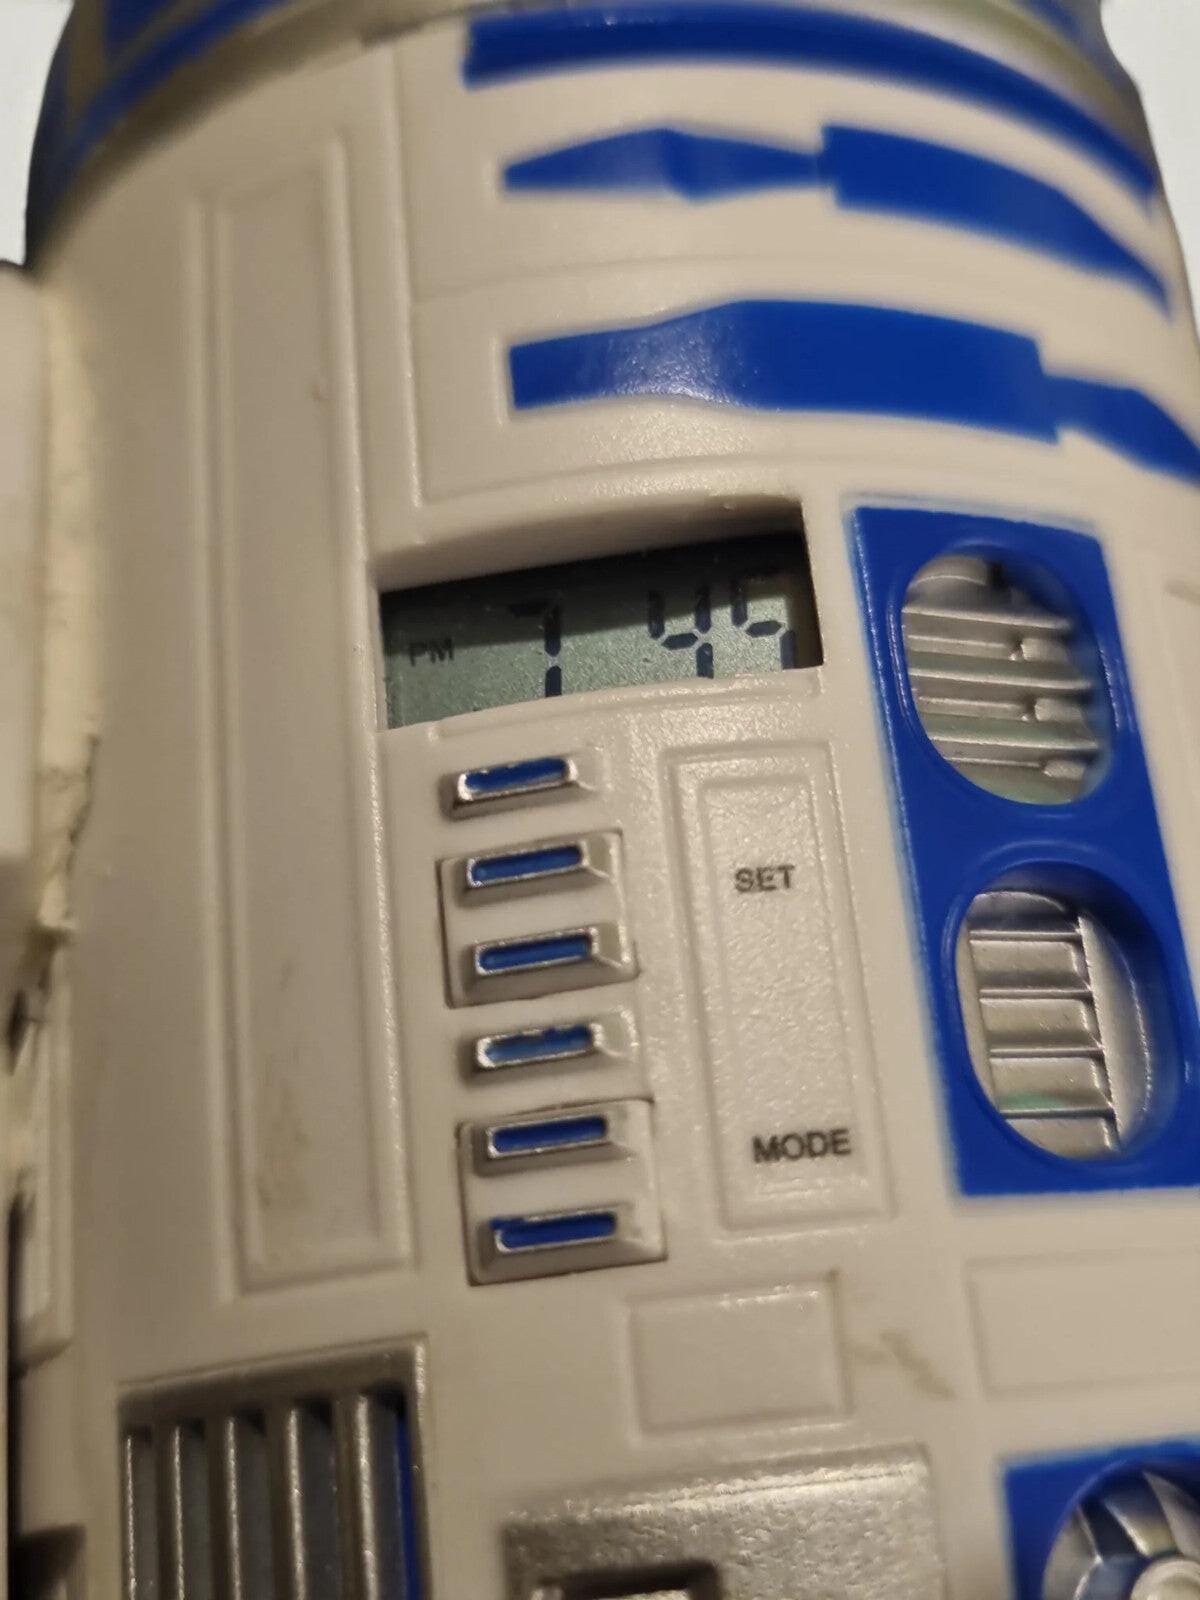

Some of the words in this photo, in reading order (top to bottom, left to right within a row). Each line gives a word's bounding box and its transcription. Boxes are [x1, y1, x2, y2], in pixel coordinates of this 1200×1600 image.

[409, 637, 454, 666] PM
[509, 599, 562, 697] 7
[734, 864, 795, 893] SET
[753, 1128, 850, 1163] MODE
